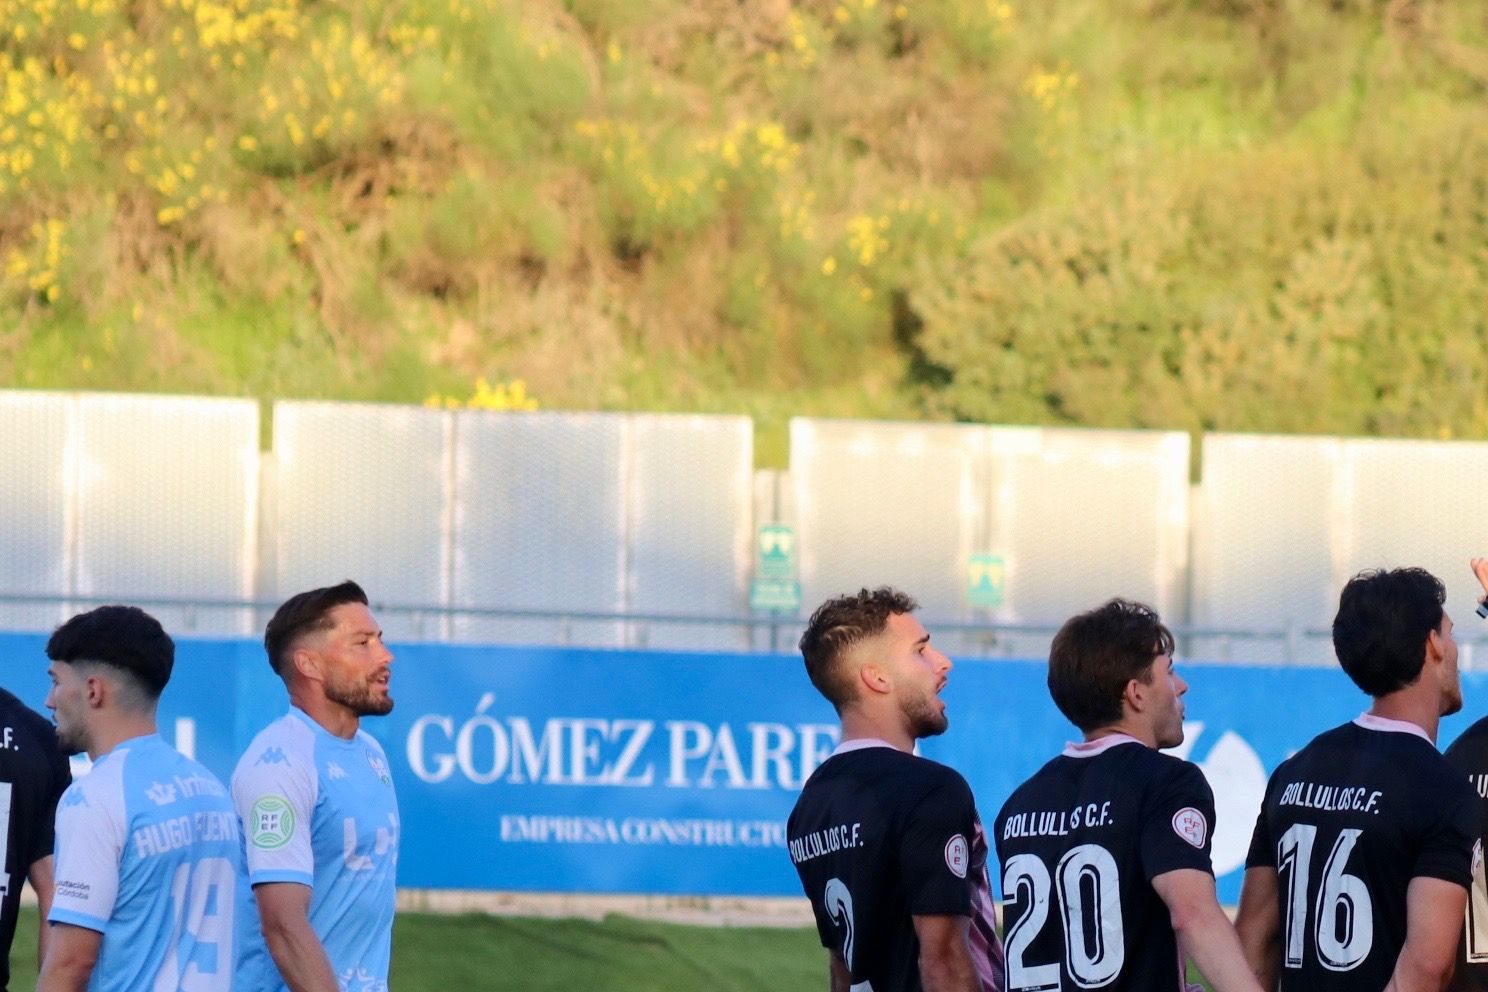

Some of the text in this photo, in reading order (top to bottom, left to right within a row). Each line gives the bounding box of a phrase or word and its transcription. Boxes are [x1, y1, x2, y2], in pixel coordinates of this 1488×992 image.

[406, 692, 655, 787] GÓMEZ
[1085, 801, 1114, 827] C.F.
[1279, 781, 1383, 815] BOLLULLOS C.F.
[134, 815, 193, 859] HUGO
[501, 815, 619, 844] EMPRESA
[840, 823, 864, 847] C.F.
[1277, 823, 1374, 972] 16
